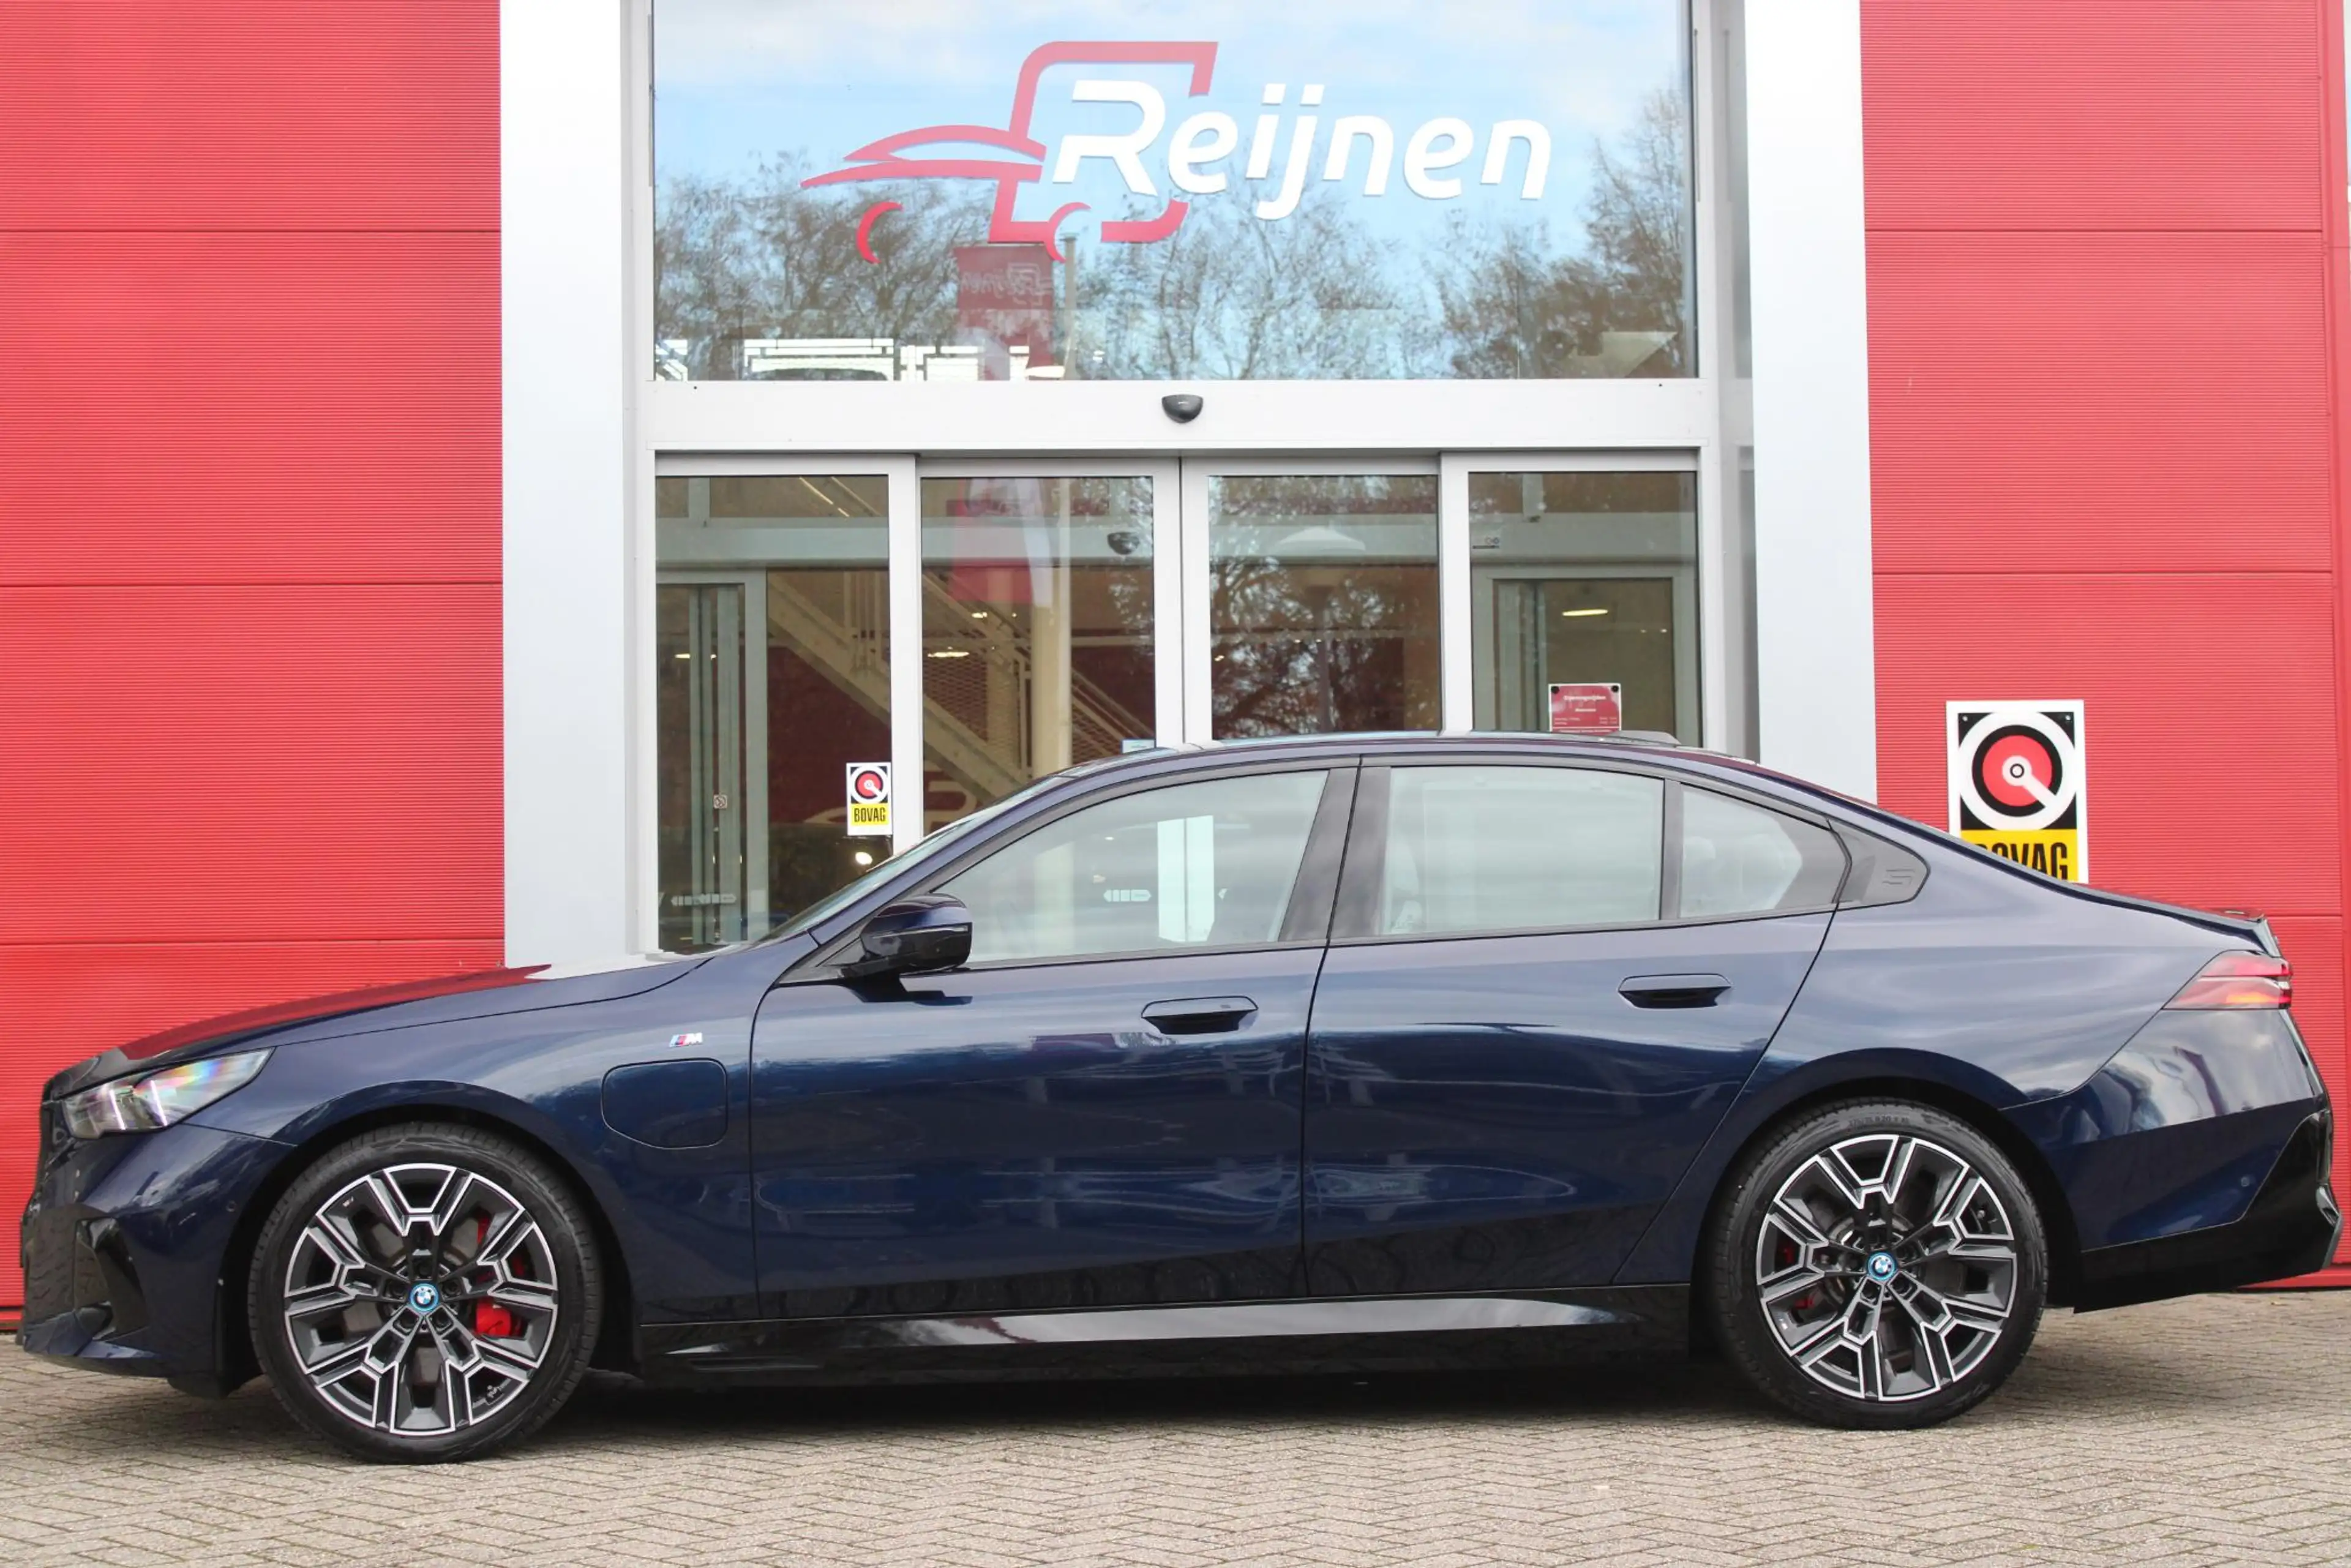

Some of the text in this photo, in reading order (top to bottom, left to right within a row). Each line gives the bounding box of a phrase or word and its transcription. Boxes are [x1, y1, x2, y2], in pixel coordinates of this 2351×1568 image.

[1052, 79, 1552, 221] Reijnen
[853, 807, 886, 822] BOVAG
[1974, 842, 2068, 880] VAG
